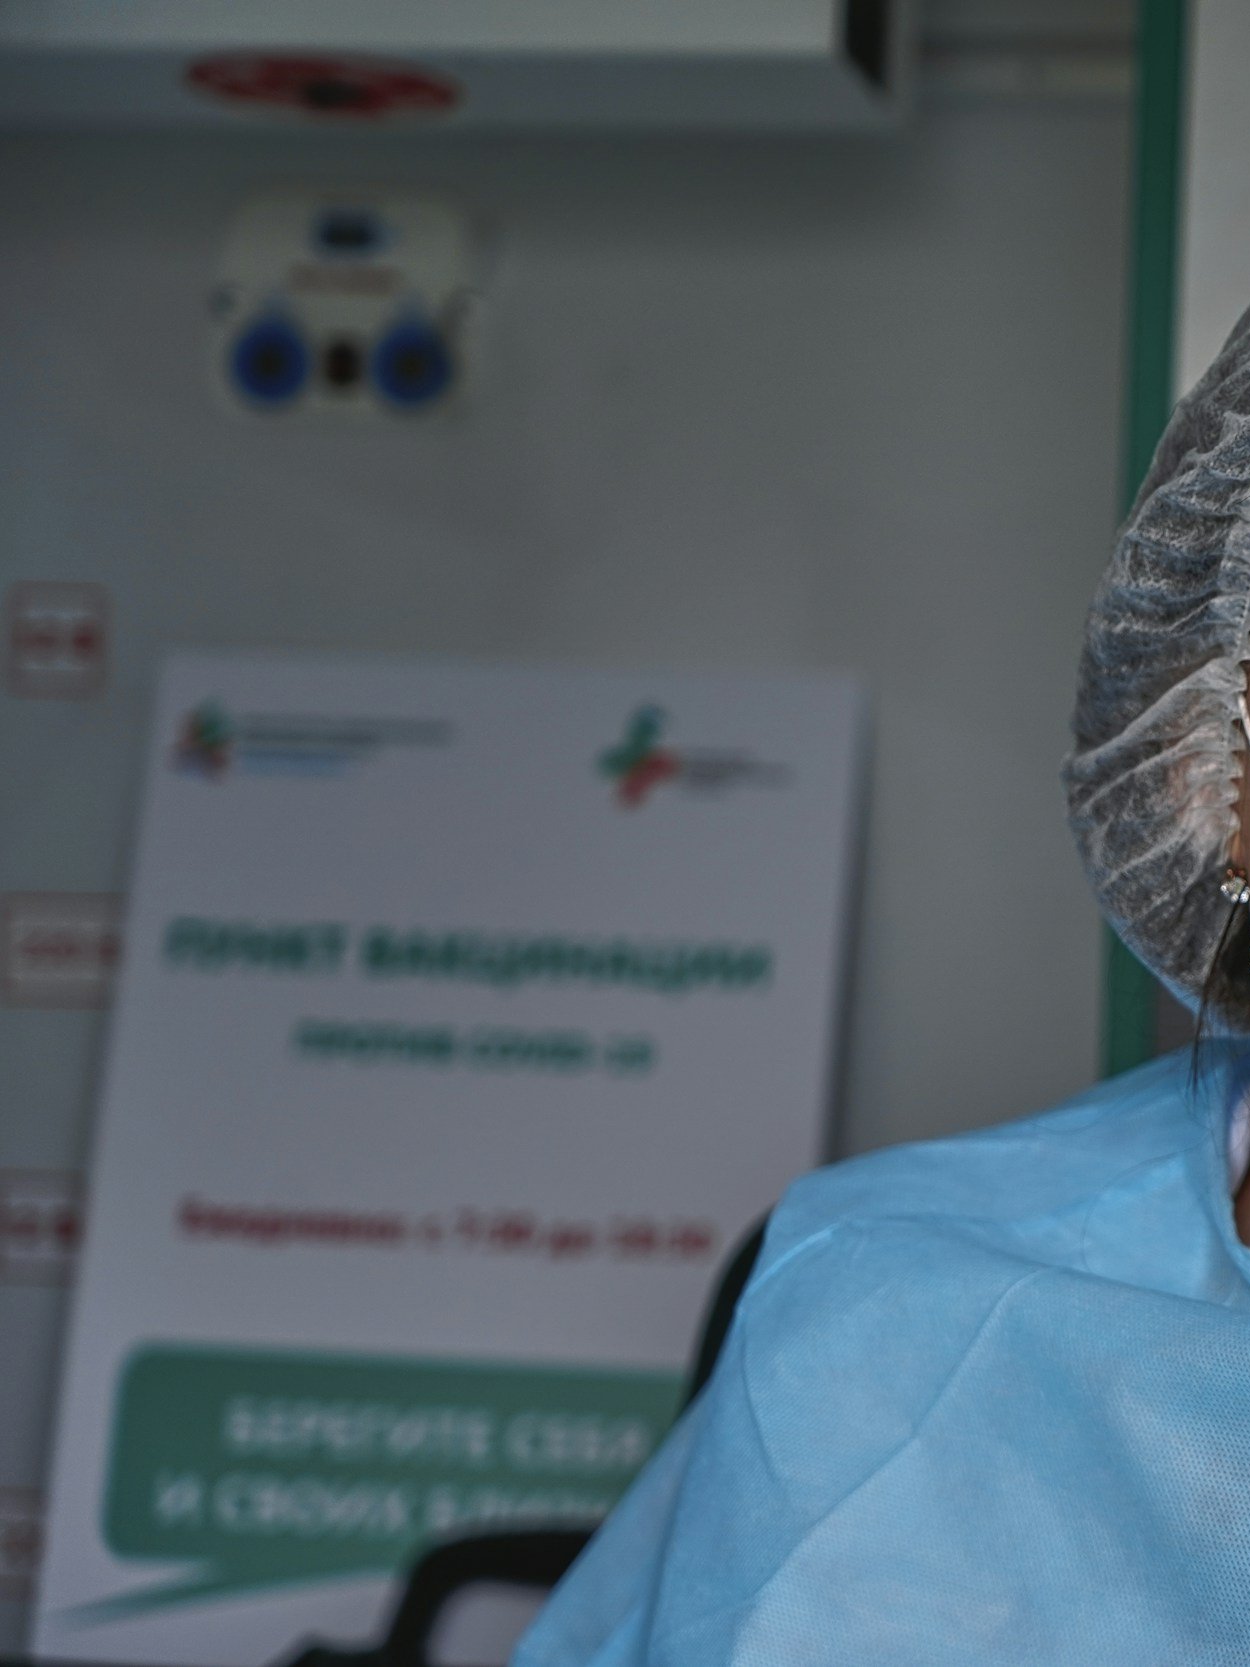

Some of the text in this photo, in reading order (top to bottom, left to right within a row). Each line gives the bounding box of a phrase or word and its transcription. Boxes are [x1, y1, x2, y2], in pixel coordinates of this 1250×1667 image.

[165, 919, 348, 976] ПУНКТ
[361, 925, 773, 995] ВАКЦИНАЦИИ
[292, 1020, 659, 1075] ПРОТИВ COVID-19
[542, 1222, 596, 1261] до
[225, 1402, 648, 1468] БЕРЕГИТЕ СЕБЯ
[154, 1475, 203, 1524] И
[214, 1477, 409, 1535] СВОИХ
